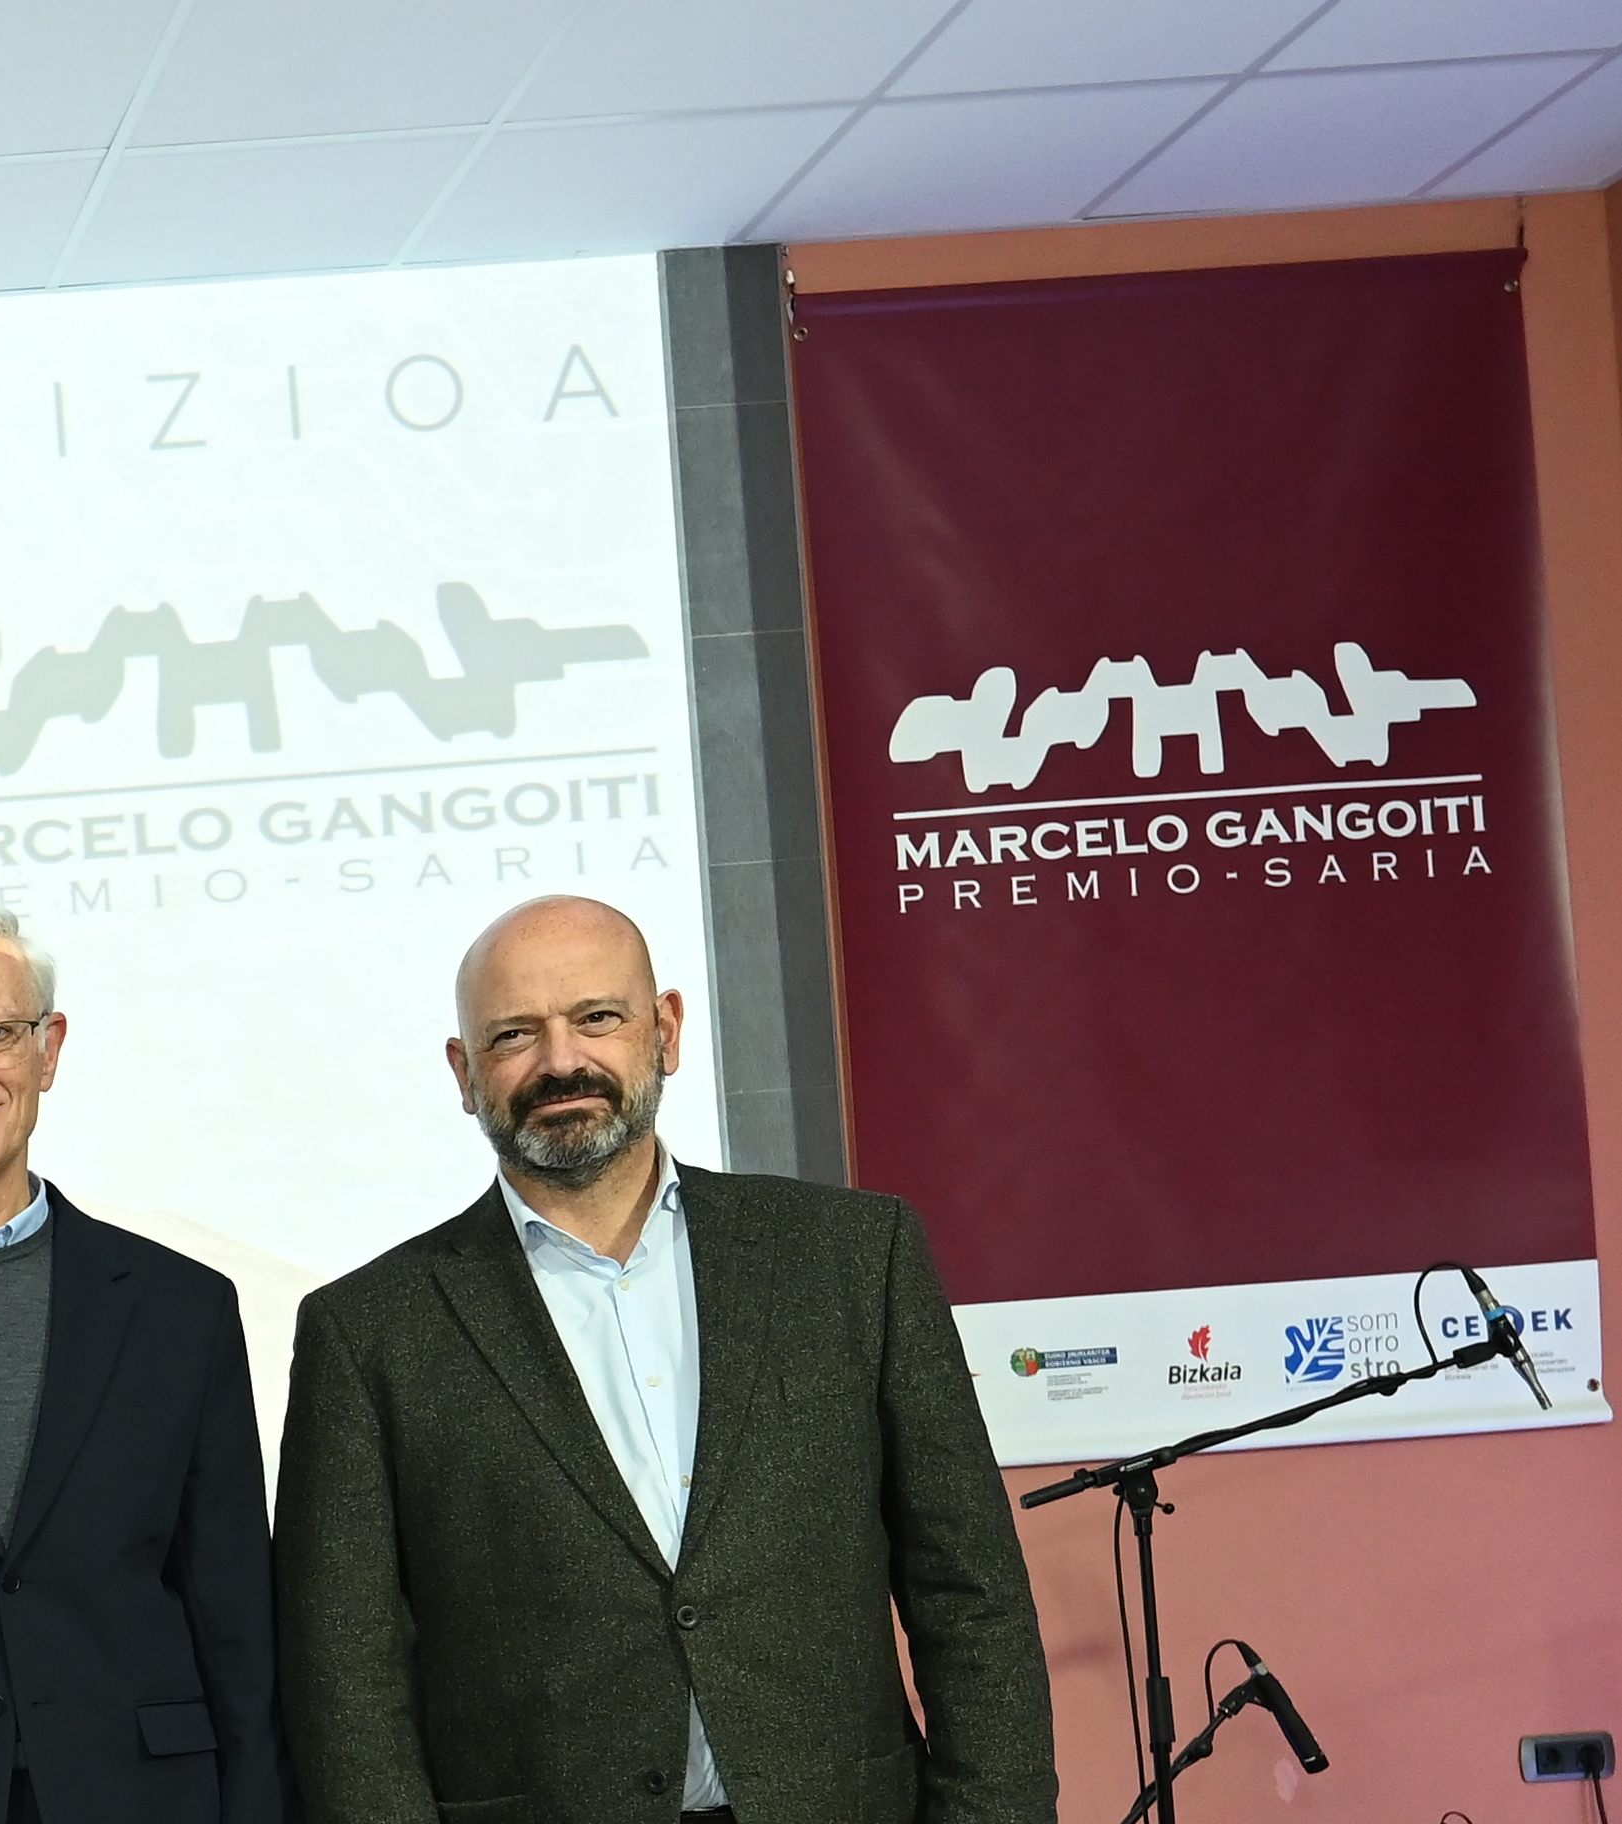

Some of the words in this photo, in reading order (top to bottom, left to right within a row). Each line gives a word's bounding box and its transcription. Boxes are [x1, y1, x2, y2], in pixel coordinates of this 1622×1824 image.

[259, 774, 662, 846] GANGOITI
[893, 813, 1191, 871] MARCELO
[1204, 794, 1487, 849] GANGOITI
[897, 845, 1493, 914] PREMIO-SARIA
[1347, 1312, 1399, 1333] som
[1348, 1334, 1400, 1355] orro
[1168, 1361, 1242, 1385] Bizkaia
[1350, 1356, 1402, 1379] stro
